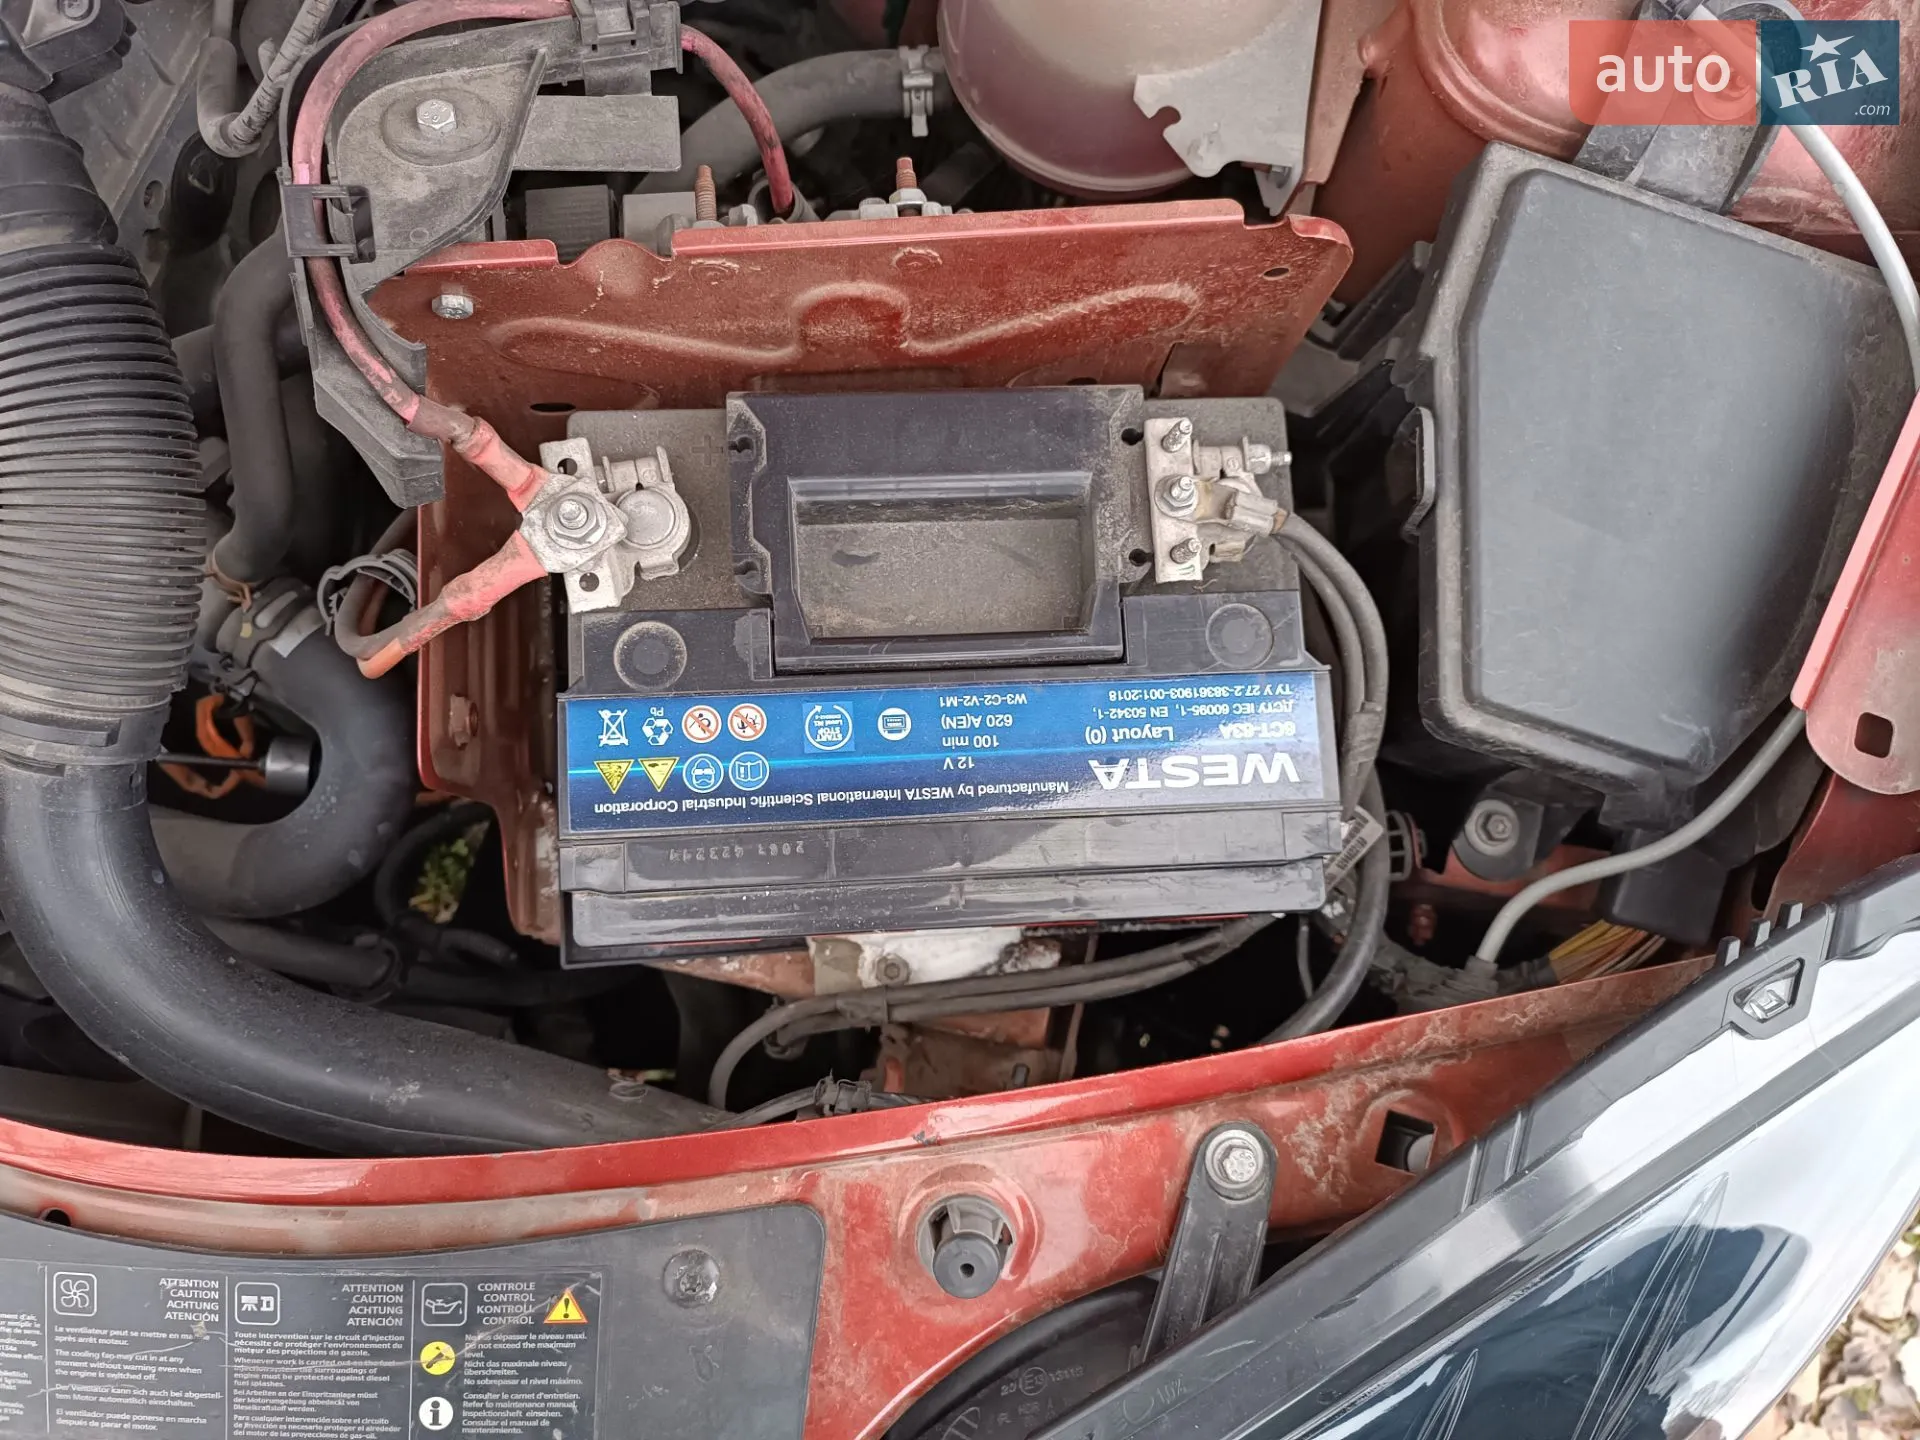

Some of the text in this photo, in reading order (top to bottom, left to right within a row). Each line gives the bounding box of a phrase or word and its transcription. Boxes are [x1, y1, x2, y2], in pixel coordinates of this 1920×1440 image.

[939, 693, 1027, 708] W3-C2-V2-M1
[649, 706, 665, 717] Pb
[1092, 706, 1147, 720] 50342-1,
[1150, 706, 1169, 718] EN
[1232, 701, 1255, 716] IEC
[941, 713, 1014, 730] 620 A(EN)
[1085, 725, 1108, 745] (0)
[1112, 723, 1174, 744] Layout
[942, 734, 1000, 749] 100 min
[943, 755, 975, 770] 12 V
[1088, 752, 1300, 790] WESTA
[593, 781, 1069, 815] Manufactured by WESTA International Scientific Industrial Corporation
[159, 1277, 219, 1289] ATTENTION
[477, 1282, 536, 1292] CONTROLE
[341, 1284, 404, 1293] ATTENTION
[170, 1289, 219, 1299] CAUTION
[352, 1294, 404, 1304] CAUTION
[483, 1293, 536, 1303] CONTROL
[166, 1300, 219, 1311] ACHTUNG
[348, 1305, 404, 1315] ACHTUNG
[164, 1311, 219, 1322] ATENCIÓN
[346, 1316, 404, 1326] ATENCIÓN
[482, 1316, 535, 1326] CONTROL
[233, 1331, 257, 1339] Toute
[529, 1332, 537, 1340] le
[538, 1332, 565, 1340] niveau
[273, 1339, 284, 1347] de
[477, 1342, 492, 1350] not
[493, 1341, 521, 1350] exceed
[522, 1341, 536, 1349] the
[536, 1341, 576, 1349] maximum
[265, 1347, 281, 1355] des
[328, 1348, 340, 1356] de
[464, 1350, 485, 1359] level.
[169, 1356, 184, 1364] any
[463, 1360, 485, 1368] Nicht
[486, 1360, 500, 1368] das
[501, 1359, 539, 1368] maximale
[178, 1366, 203, 1374] when
[476, 1377, 519, 1386] sobrepasar
[520, 1377, 528, 1385] el
[529, 1377, 549, 1385] nivel
[462, 1391, 501, 1400] Consulter
[501, 1392, 510, 1400] le
[510, 1392, 535, 1400] carnet
[462, 1400, 484, 1408] Refer
[462, 1409, 563, 1419] Inspektionsheft einsehen.
[462, 1418, 550, 1427] Consultar el manual de
